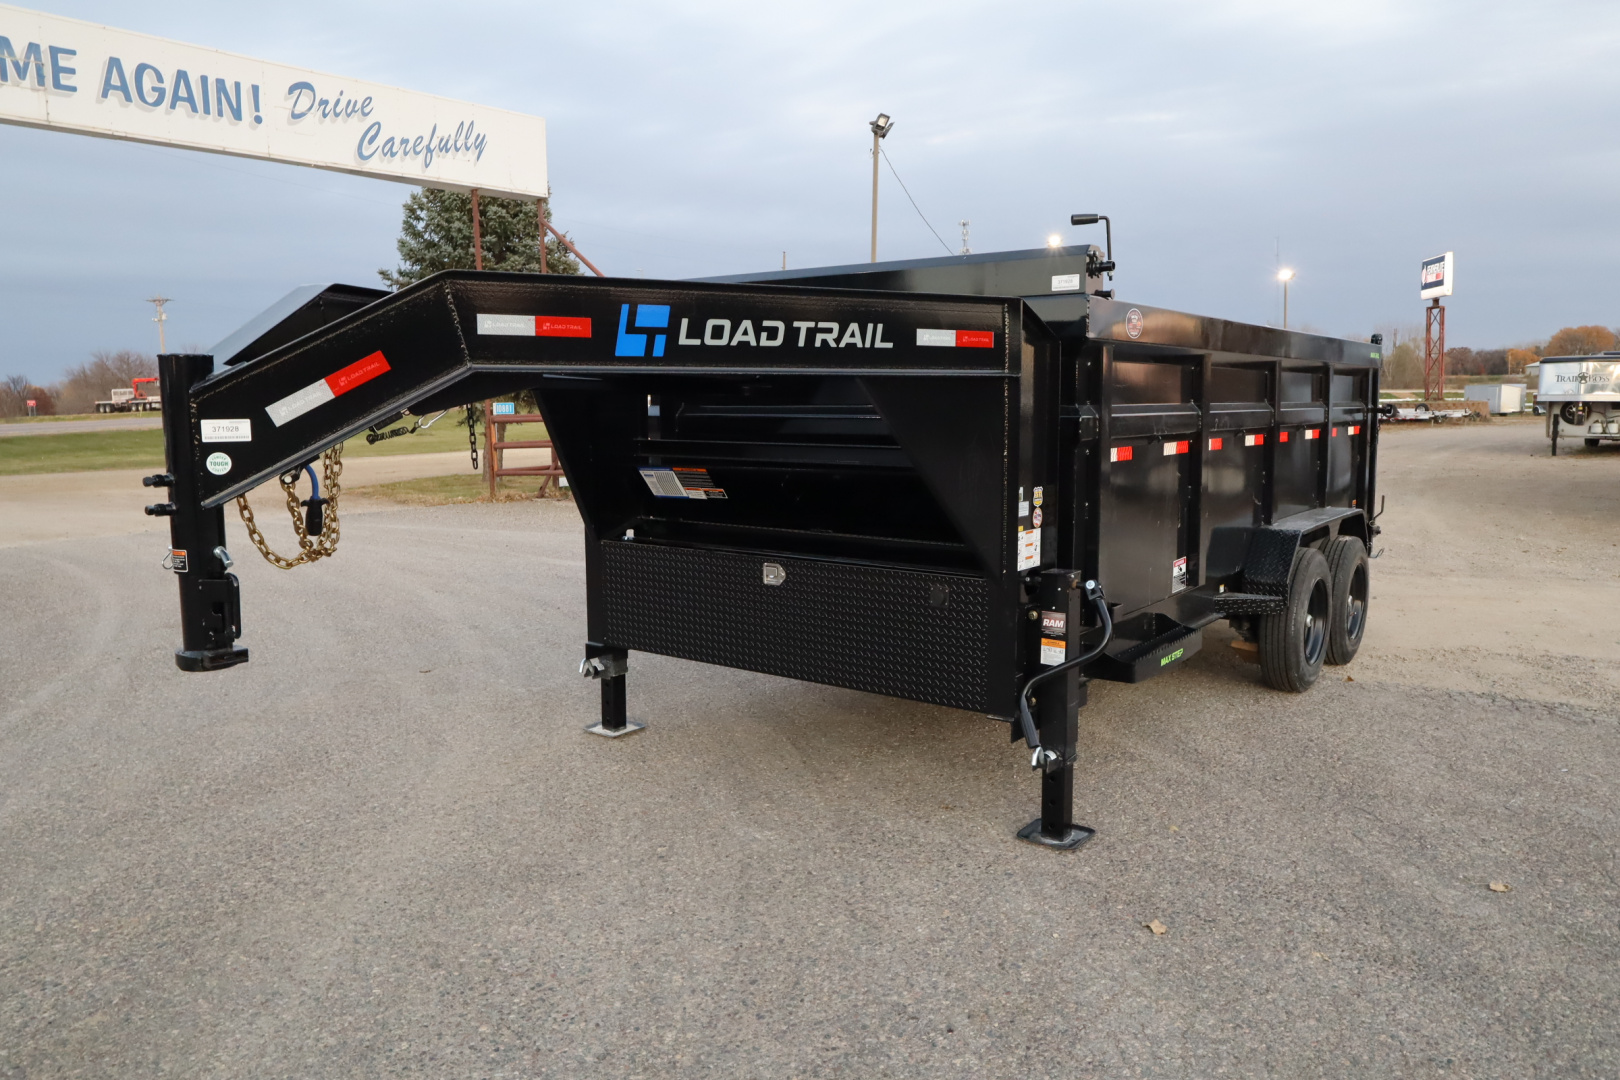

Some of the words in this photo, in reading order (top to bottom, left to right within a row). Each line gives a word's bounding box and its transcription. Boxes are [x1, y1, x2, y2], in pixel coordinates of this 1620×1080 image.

[101, 56, 263, 124] AGAIN!
[287, 81, 374, 120] Drive
[357, 120, 487, 168] Carefully
[678, 317, 786, 347] LOAD
[793, 321, 894, 348] TRAIL
[347, 369, 364, 381] LOAD
[362, 361, 381, 375] TRAIL
[1042, 618, 1065, 628] RAM
